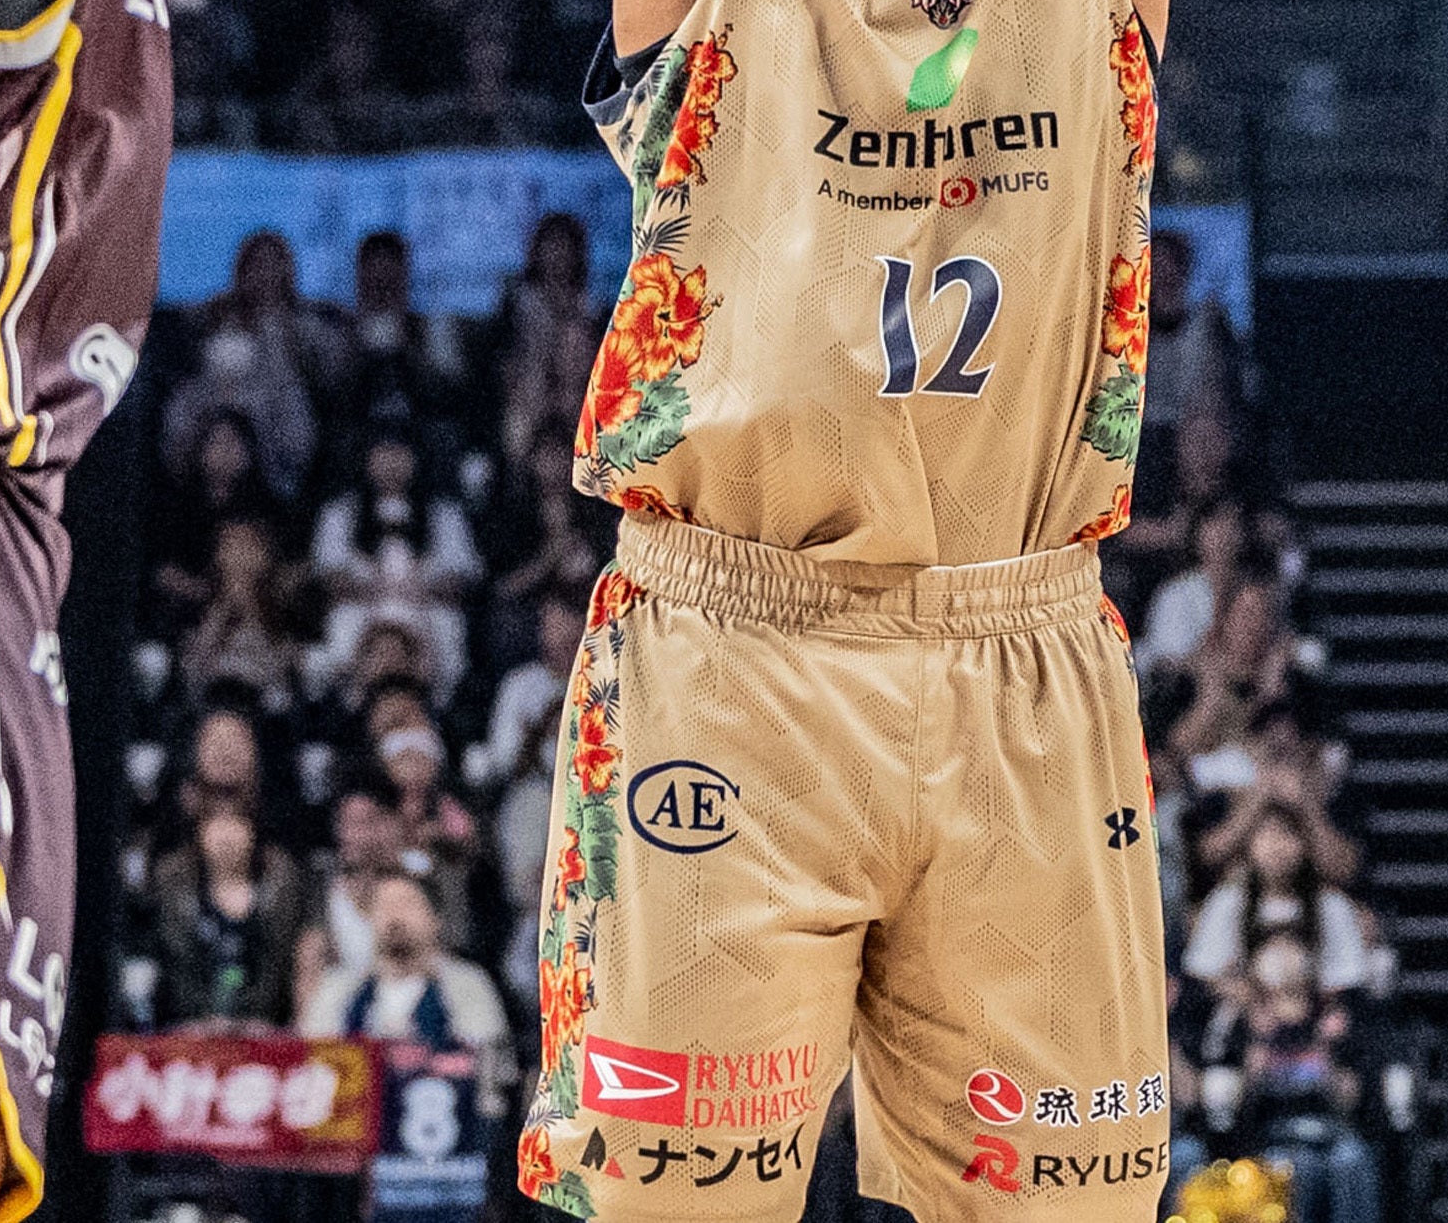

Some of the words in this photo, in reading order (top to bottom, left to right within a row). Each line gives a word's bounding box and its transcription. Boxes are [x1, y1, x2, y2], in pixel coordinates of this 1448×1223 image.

[817, 180, 832, 198] A
[837, 188, 934, 211] member
[982, 171, 1049, 197] MUFG
[875, 255, 1003, 398] 12
[646, 779, 726, 832] AE
[695, 1042, 818, 1091] RYUKYU
[692, 1085, 819, 1129] DAIHATSU
[638, 1122, 806, 1188] ナンセイ
[1032, 1140, 1167, 1187] RYUSE
